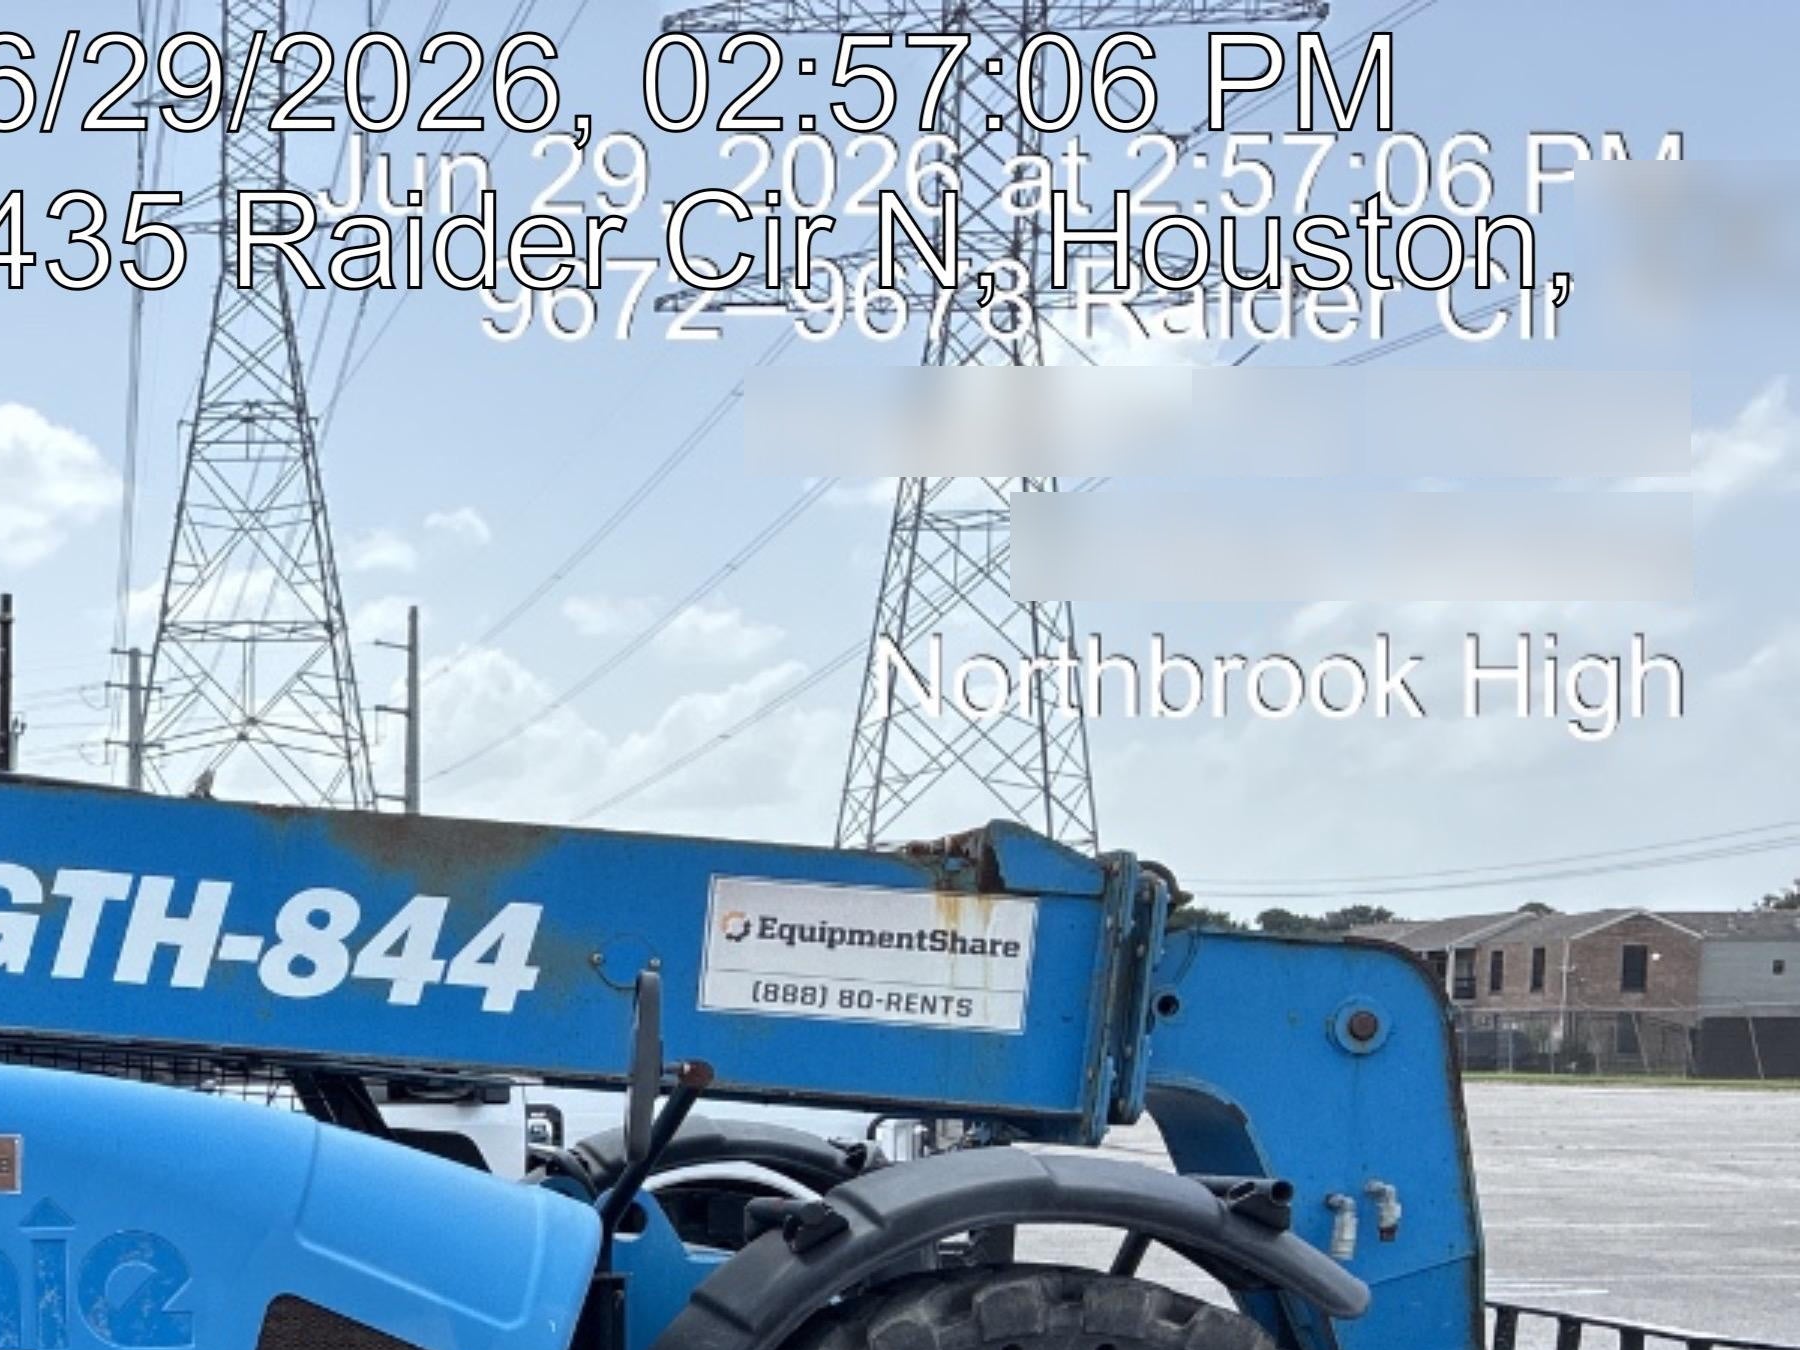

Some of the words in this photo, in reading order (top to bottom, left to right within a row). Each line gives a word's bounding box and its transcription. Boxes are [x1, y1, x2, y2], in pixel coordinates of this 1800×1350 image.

[758, 916, 1021, 958] EquipmentShare
[752, 980, 828, 1010] (888)
[839, 985, 974, 1018] 80-RENTS
